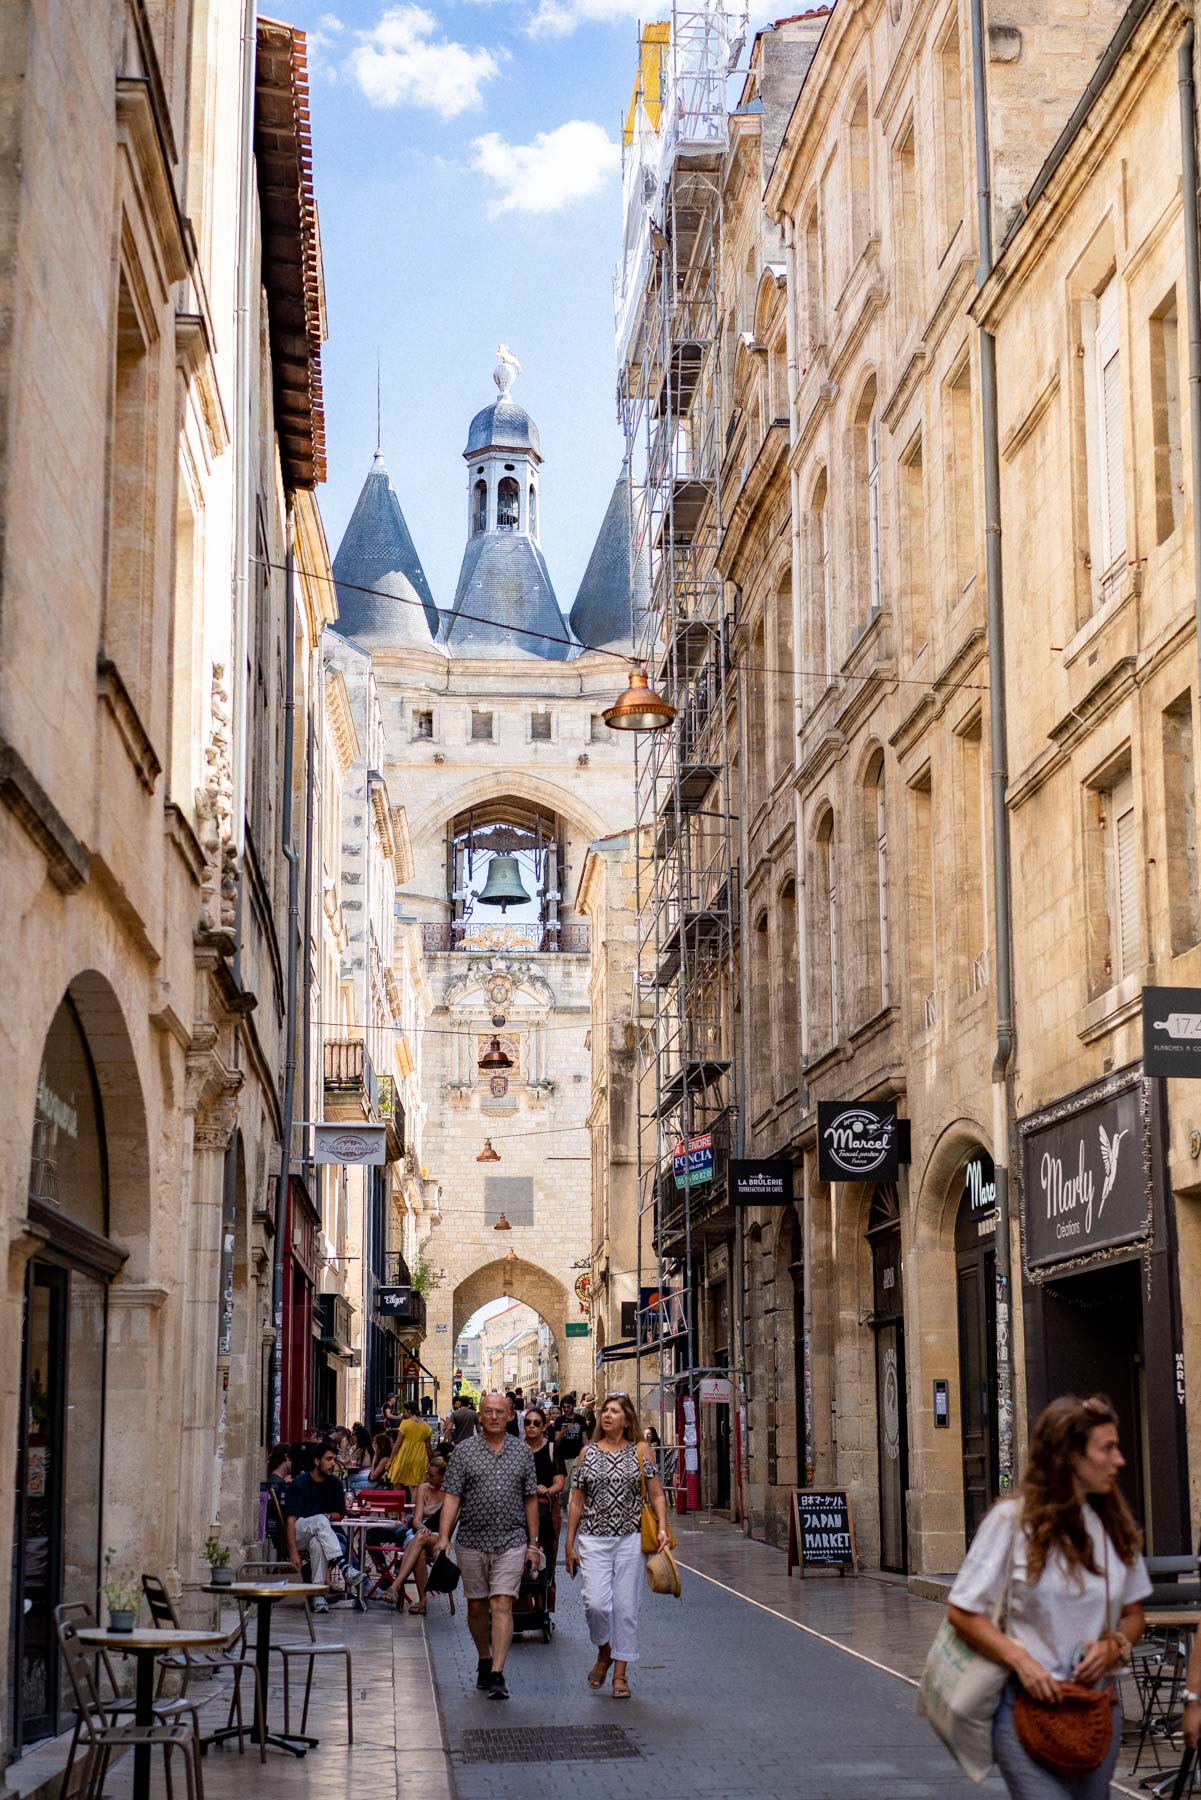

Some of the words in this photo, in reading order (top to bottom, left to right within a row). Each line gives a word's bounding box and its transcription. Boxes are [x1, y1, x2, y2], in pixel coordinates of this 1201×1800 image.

[824, 1128, 891, 1149] Marcel
[674, 1149, 712, 1168] FONCIA
[1040, 1139, 1095, 1234] Marly
[1056, 1220, 1080, 1239] Créations
[383, 1293, 407, 1308] Edgar
[1175, 1353, 1185, 1405] MARLY
[803, 1513, 842, 1528] JAPAN
[804, 1532, 850, 1548] MARKET
